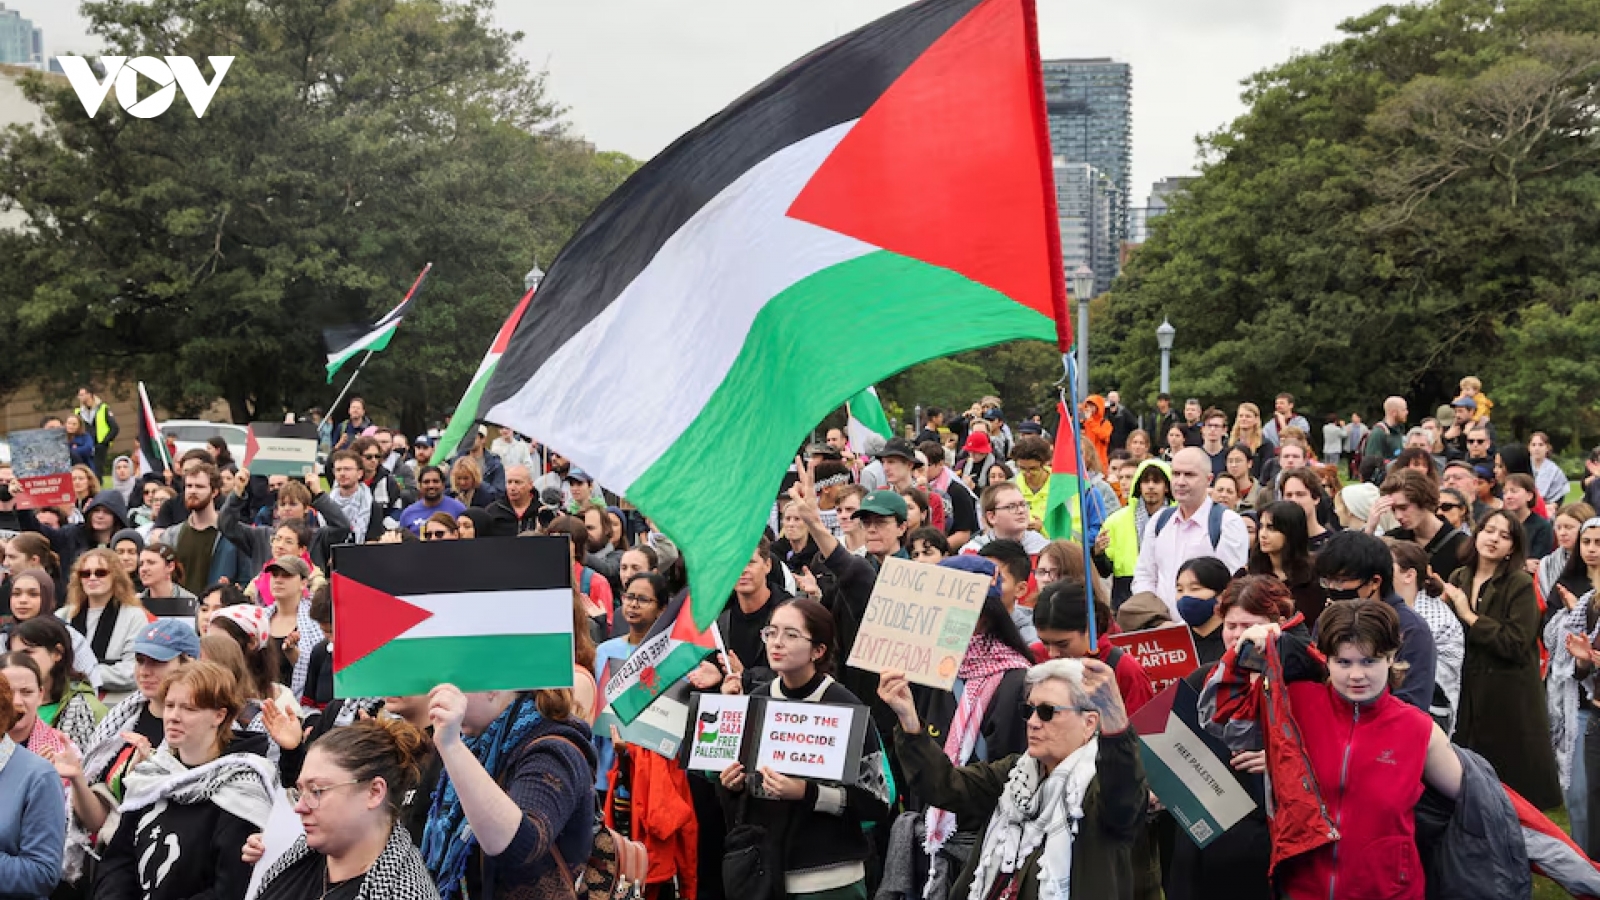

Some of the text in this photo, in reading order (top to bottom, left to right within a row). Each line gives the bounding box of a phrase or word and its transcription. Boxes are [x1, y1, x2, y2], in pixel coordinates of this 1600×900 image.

[879, 562, 980, 604] LONG LIVE
[866, 595, 943, 636] STUDENT
[852, 632, 932, 676] INTIFADA
[1137, 640, 1164, 655] ALL
[1134, 649, 1188, 667] ARTED
[721, 710, 743, 722] FREE
[774, 712, 839, 728] STOP THE
[719, 722, 741, 734] GAZA
[718, 735, 739, 747] FREE
[769, 730, 836, 747] GENOCIDE
[694, 746, 735, 760] PALESTINE
[772, 750, 825, 765] IN GAZA
[1173, 742, 1226, 797] FREE PALESTINE
